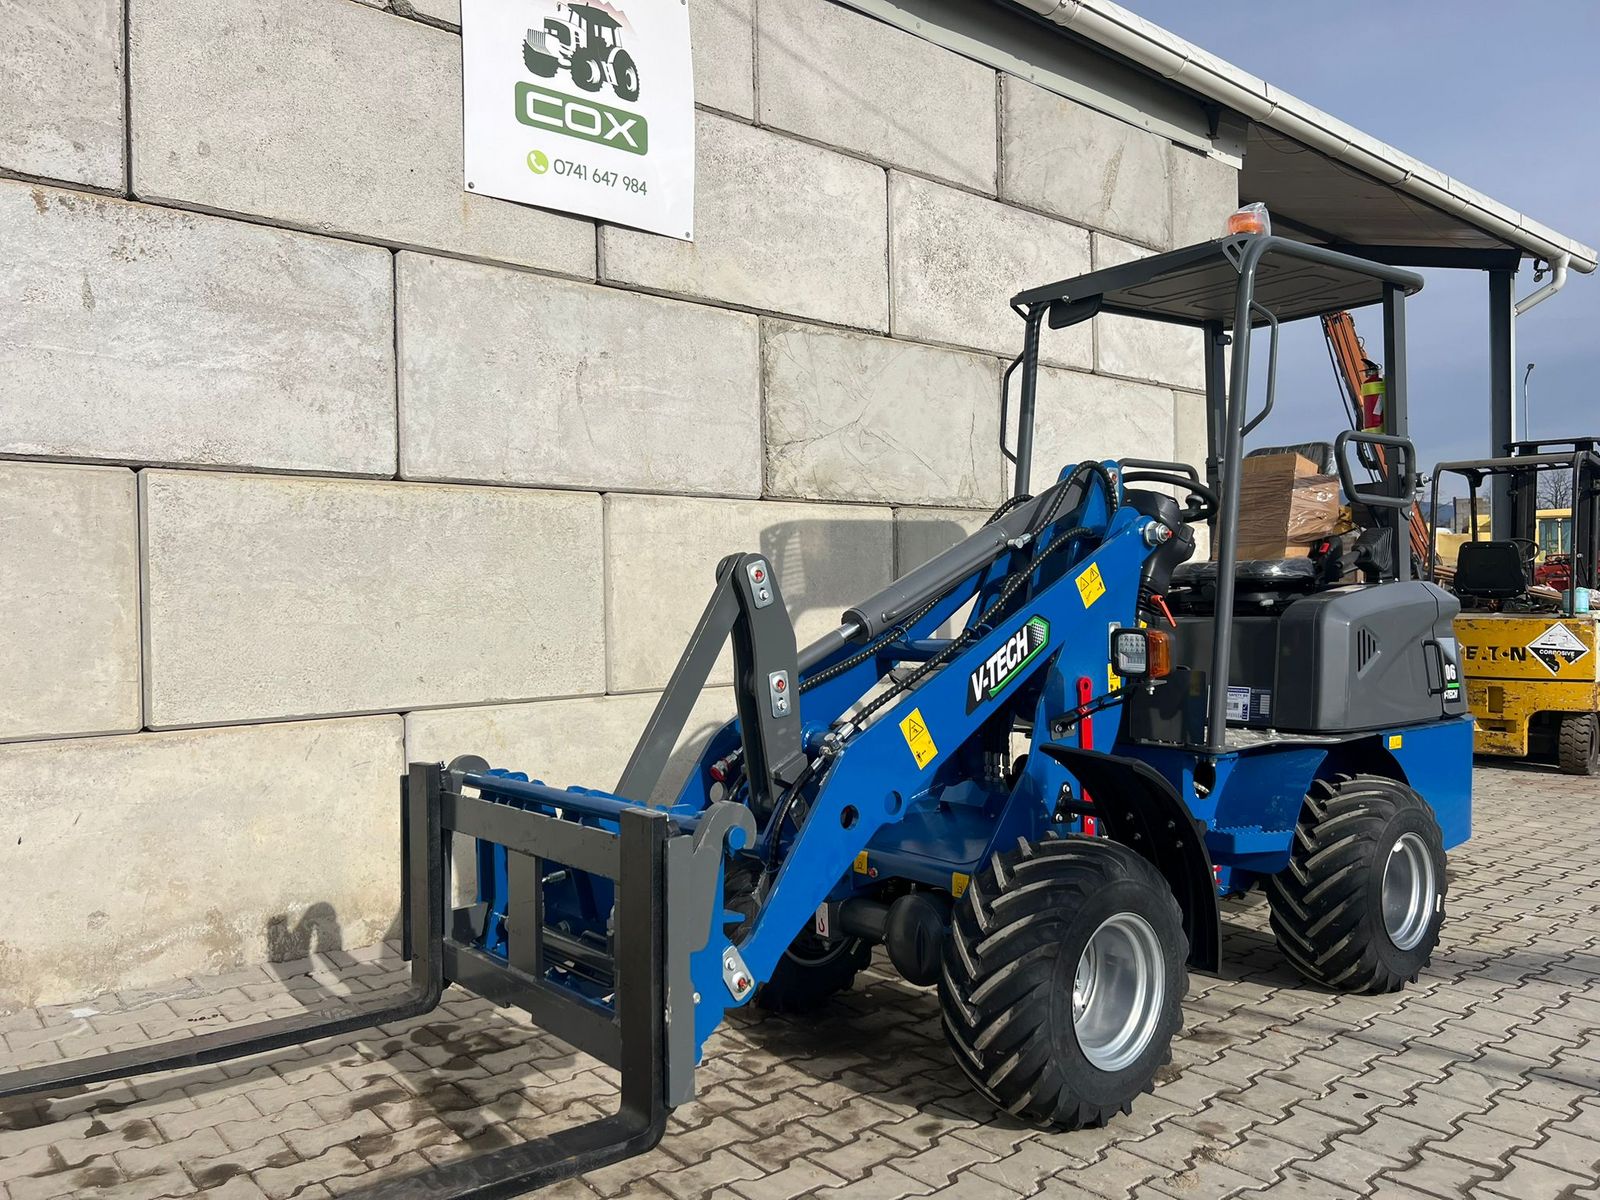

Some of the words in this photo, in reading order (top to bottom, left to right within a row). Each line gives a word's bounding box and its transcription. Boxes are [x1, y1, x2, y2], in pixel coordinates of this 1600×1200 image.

[526, 91, 638, 148] COX
[553, 158, 587, 181] 0741
[592, 168, 618, 187] 647
[622, 176, 647, 196] 984
[971, 625, 1029, 702] V-TECH
